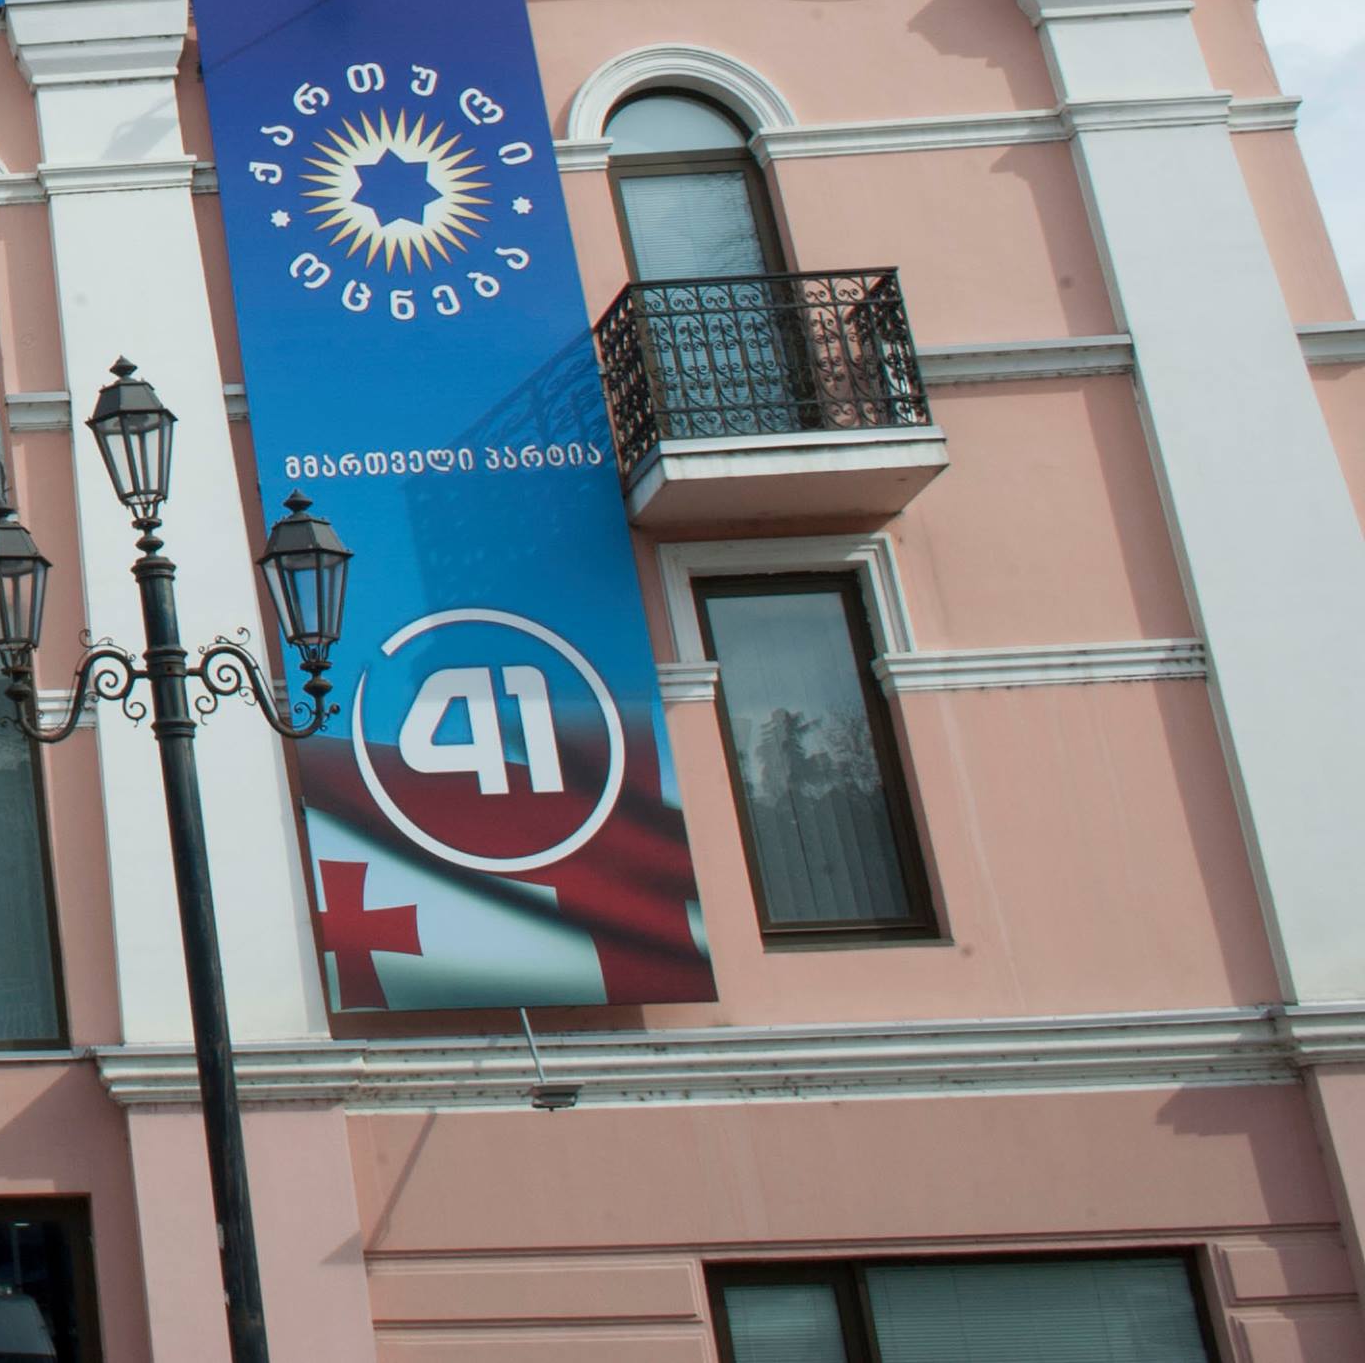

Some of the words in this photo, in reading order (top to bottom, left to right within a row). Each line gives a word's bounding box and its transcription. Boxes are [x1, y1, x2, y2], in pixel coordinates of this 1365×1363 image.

[248, 61, 534, 186] ქართული
[288, 245, 530, 321] ოცნება
[284, 447, 475, 480] მმართველი
[484, 441, 603, 471] პარტია
[399, 664, 564, 795] 41
